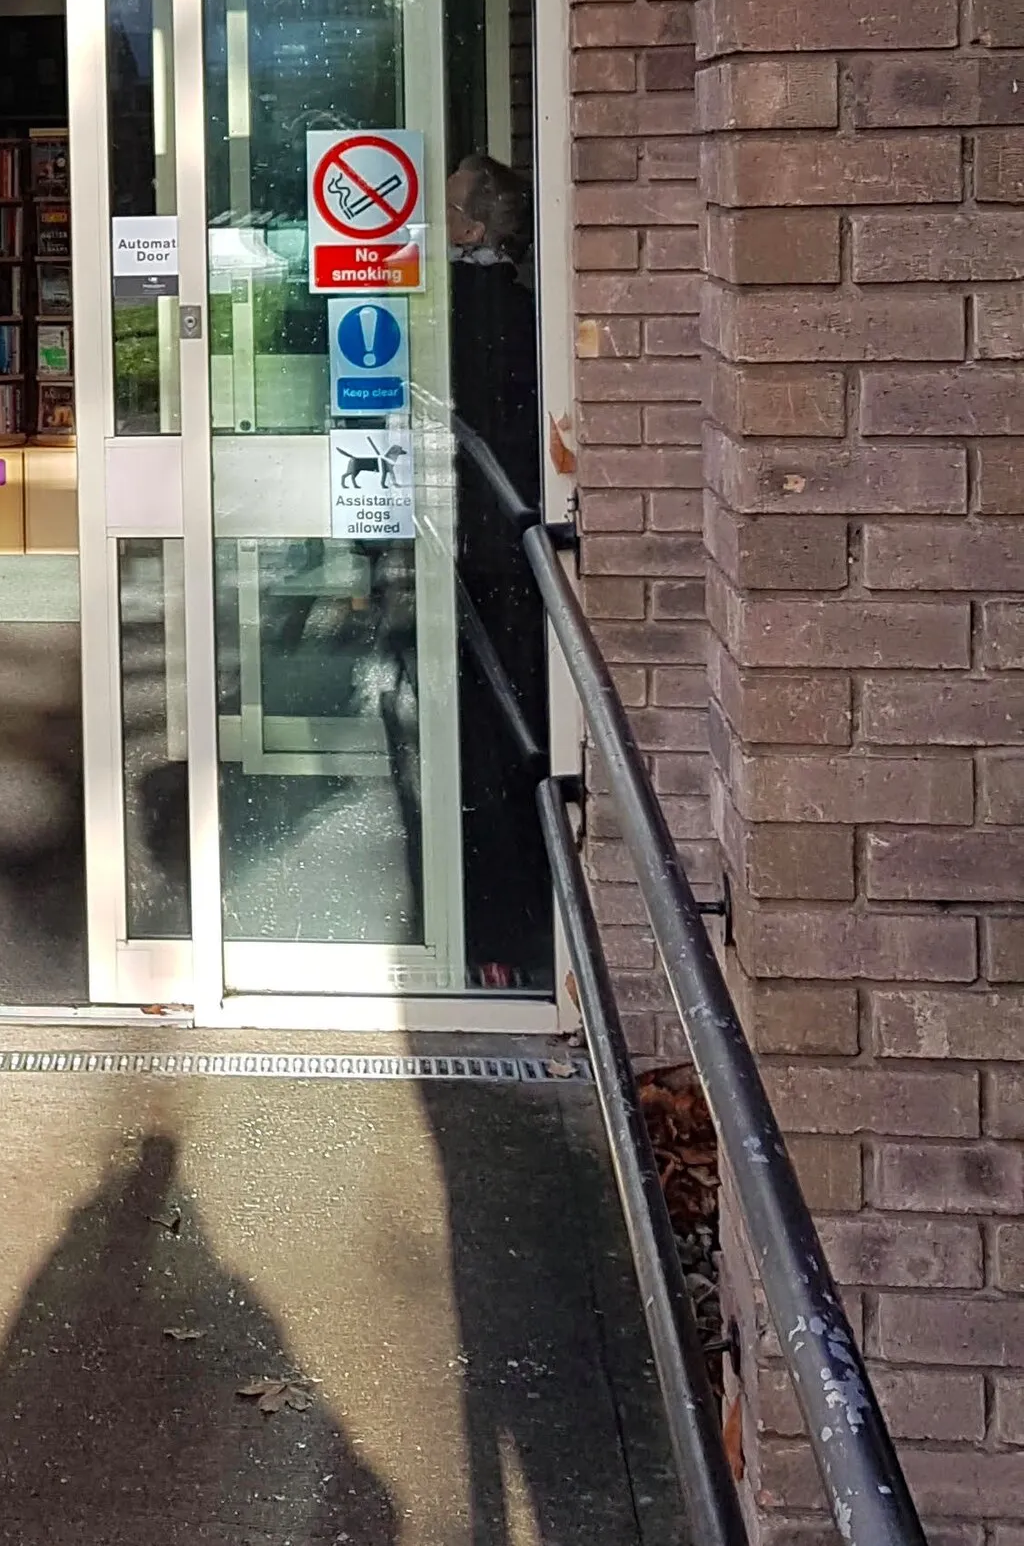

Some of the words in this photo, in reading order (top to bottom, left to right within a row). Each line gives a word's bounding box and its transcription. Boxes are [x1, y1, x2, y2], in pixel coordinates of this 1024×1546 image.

[137, 251, 170, 262] Door
[355, 248, 378, 263] No
[332, 266, 403, 283] smoking
[342, 387, 369, 399] Keep
[372, 387, 399, 398] clear
[336, 494, 412, 507] Assistance
[356, 508, 391, 523] dogs
[347, 522, 401, 534] allowed
